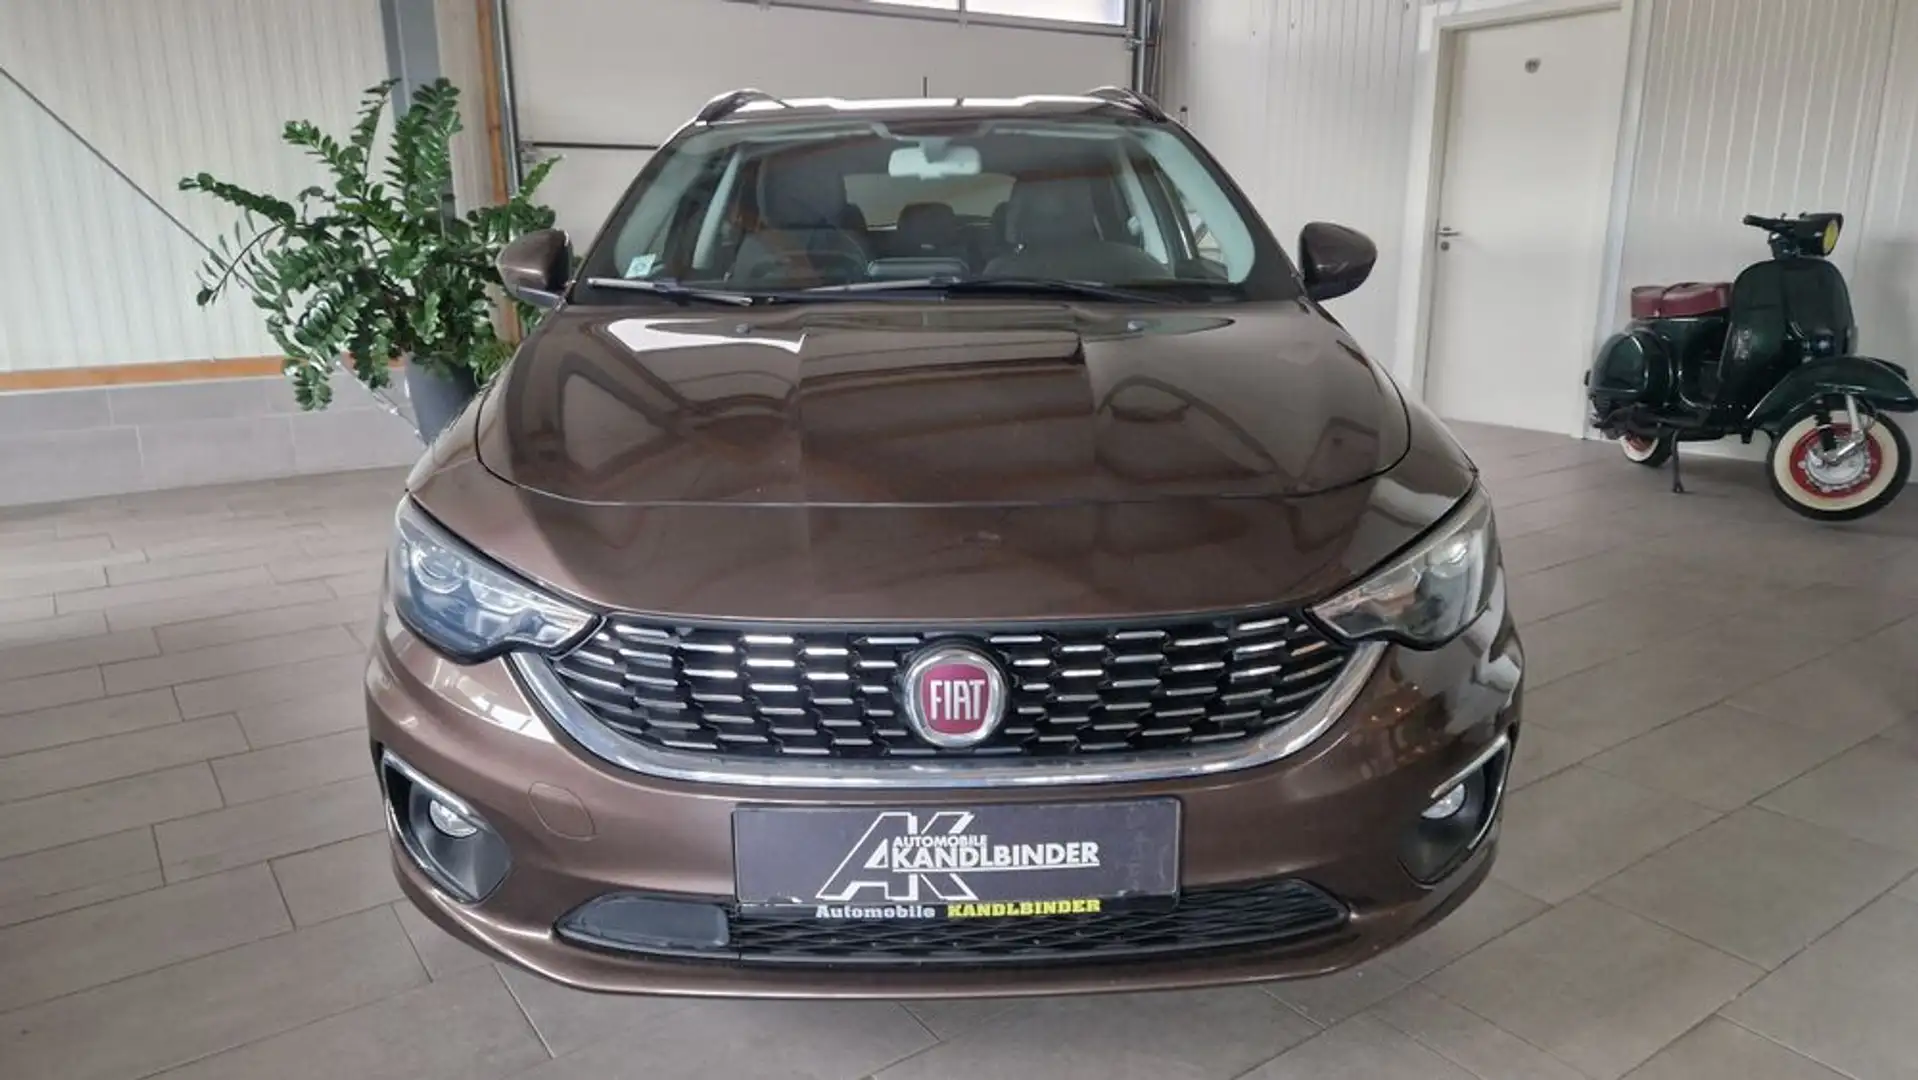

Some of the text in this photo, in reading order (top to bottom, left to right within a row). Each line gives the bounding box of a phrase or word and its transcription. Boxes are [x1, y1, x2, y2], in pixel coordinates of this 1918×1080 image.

[930, 679, 986, 720] FIAT
[892, 834, 988, 848] AUTOMOBILE
[892, 841, 1100, 869] KANDLBINDER
[815, 898, 1101, 919] Automobile KANDLBINDER
